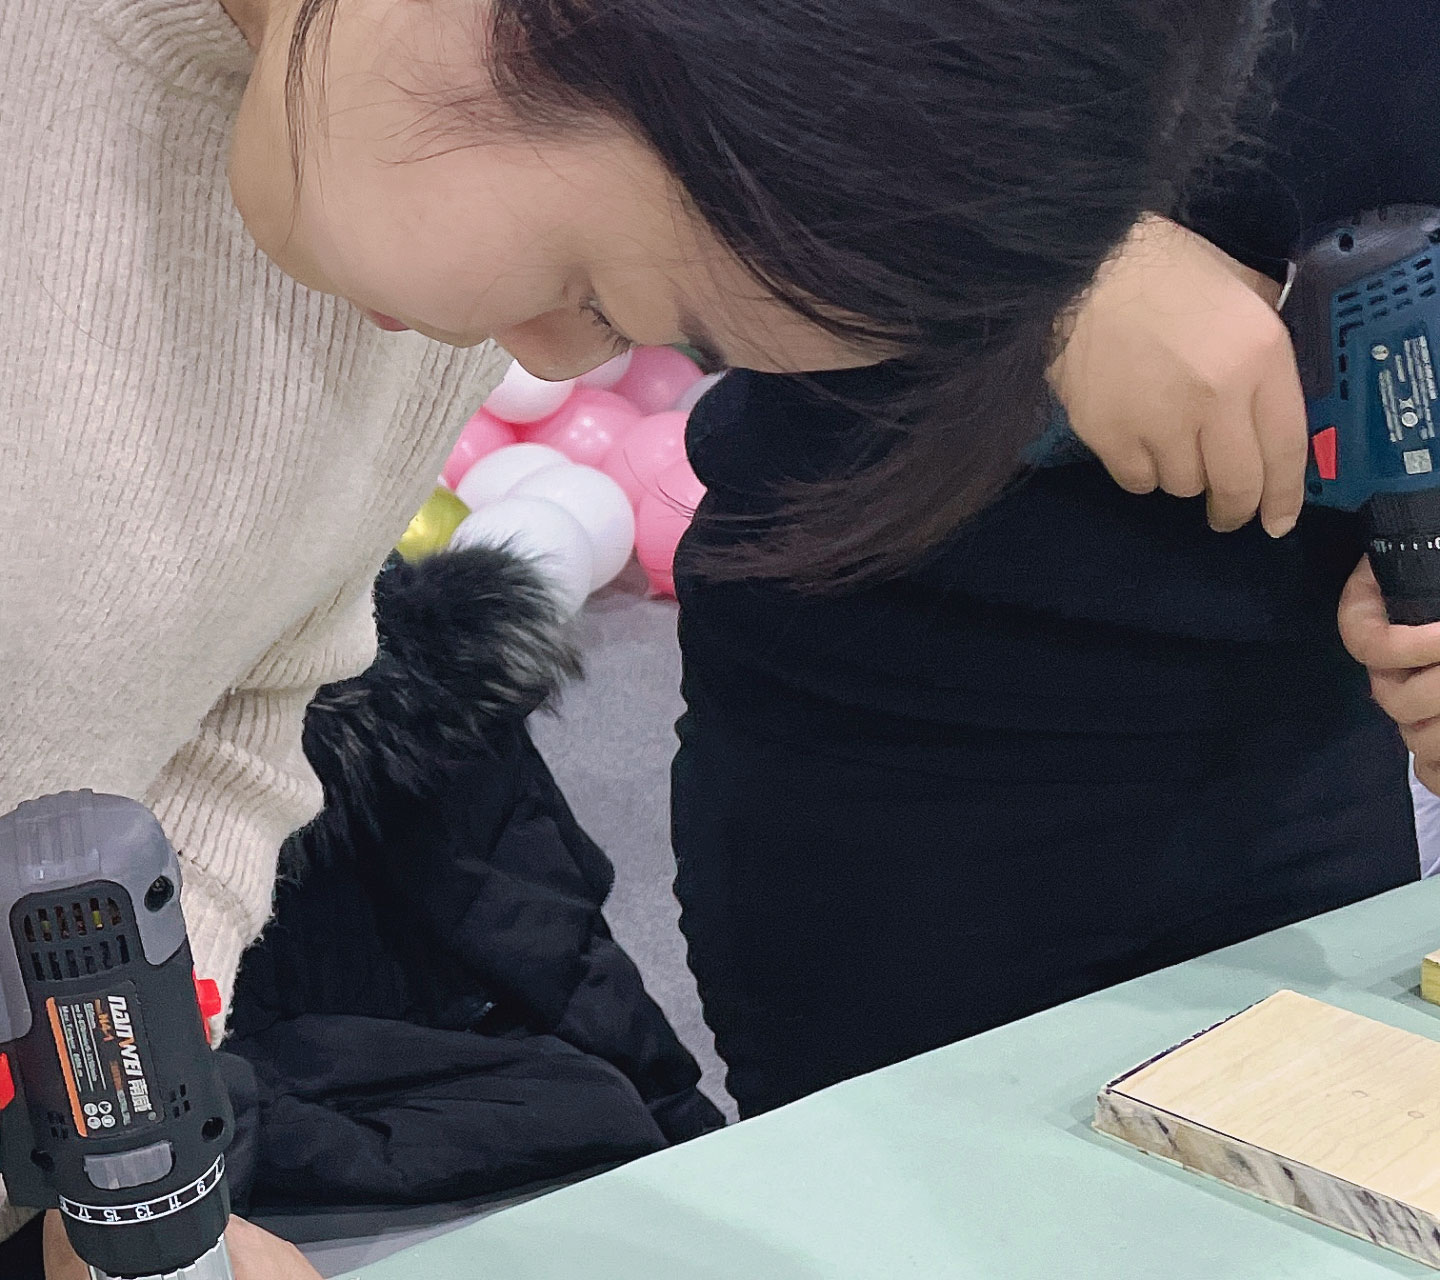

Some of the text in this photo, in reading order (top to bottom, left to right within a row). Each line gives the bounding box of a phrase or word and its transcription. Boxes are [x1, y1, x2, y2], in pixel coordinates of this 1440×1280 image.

[168, 1195, 182, 1210] 11
[78, 1207, 91, 1220] 17
[103, 1209, 121, 1222] 15
[135, 1205, 153, 1220] 13
